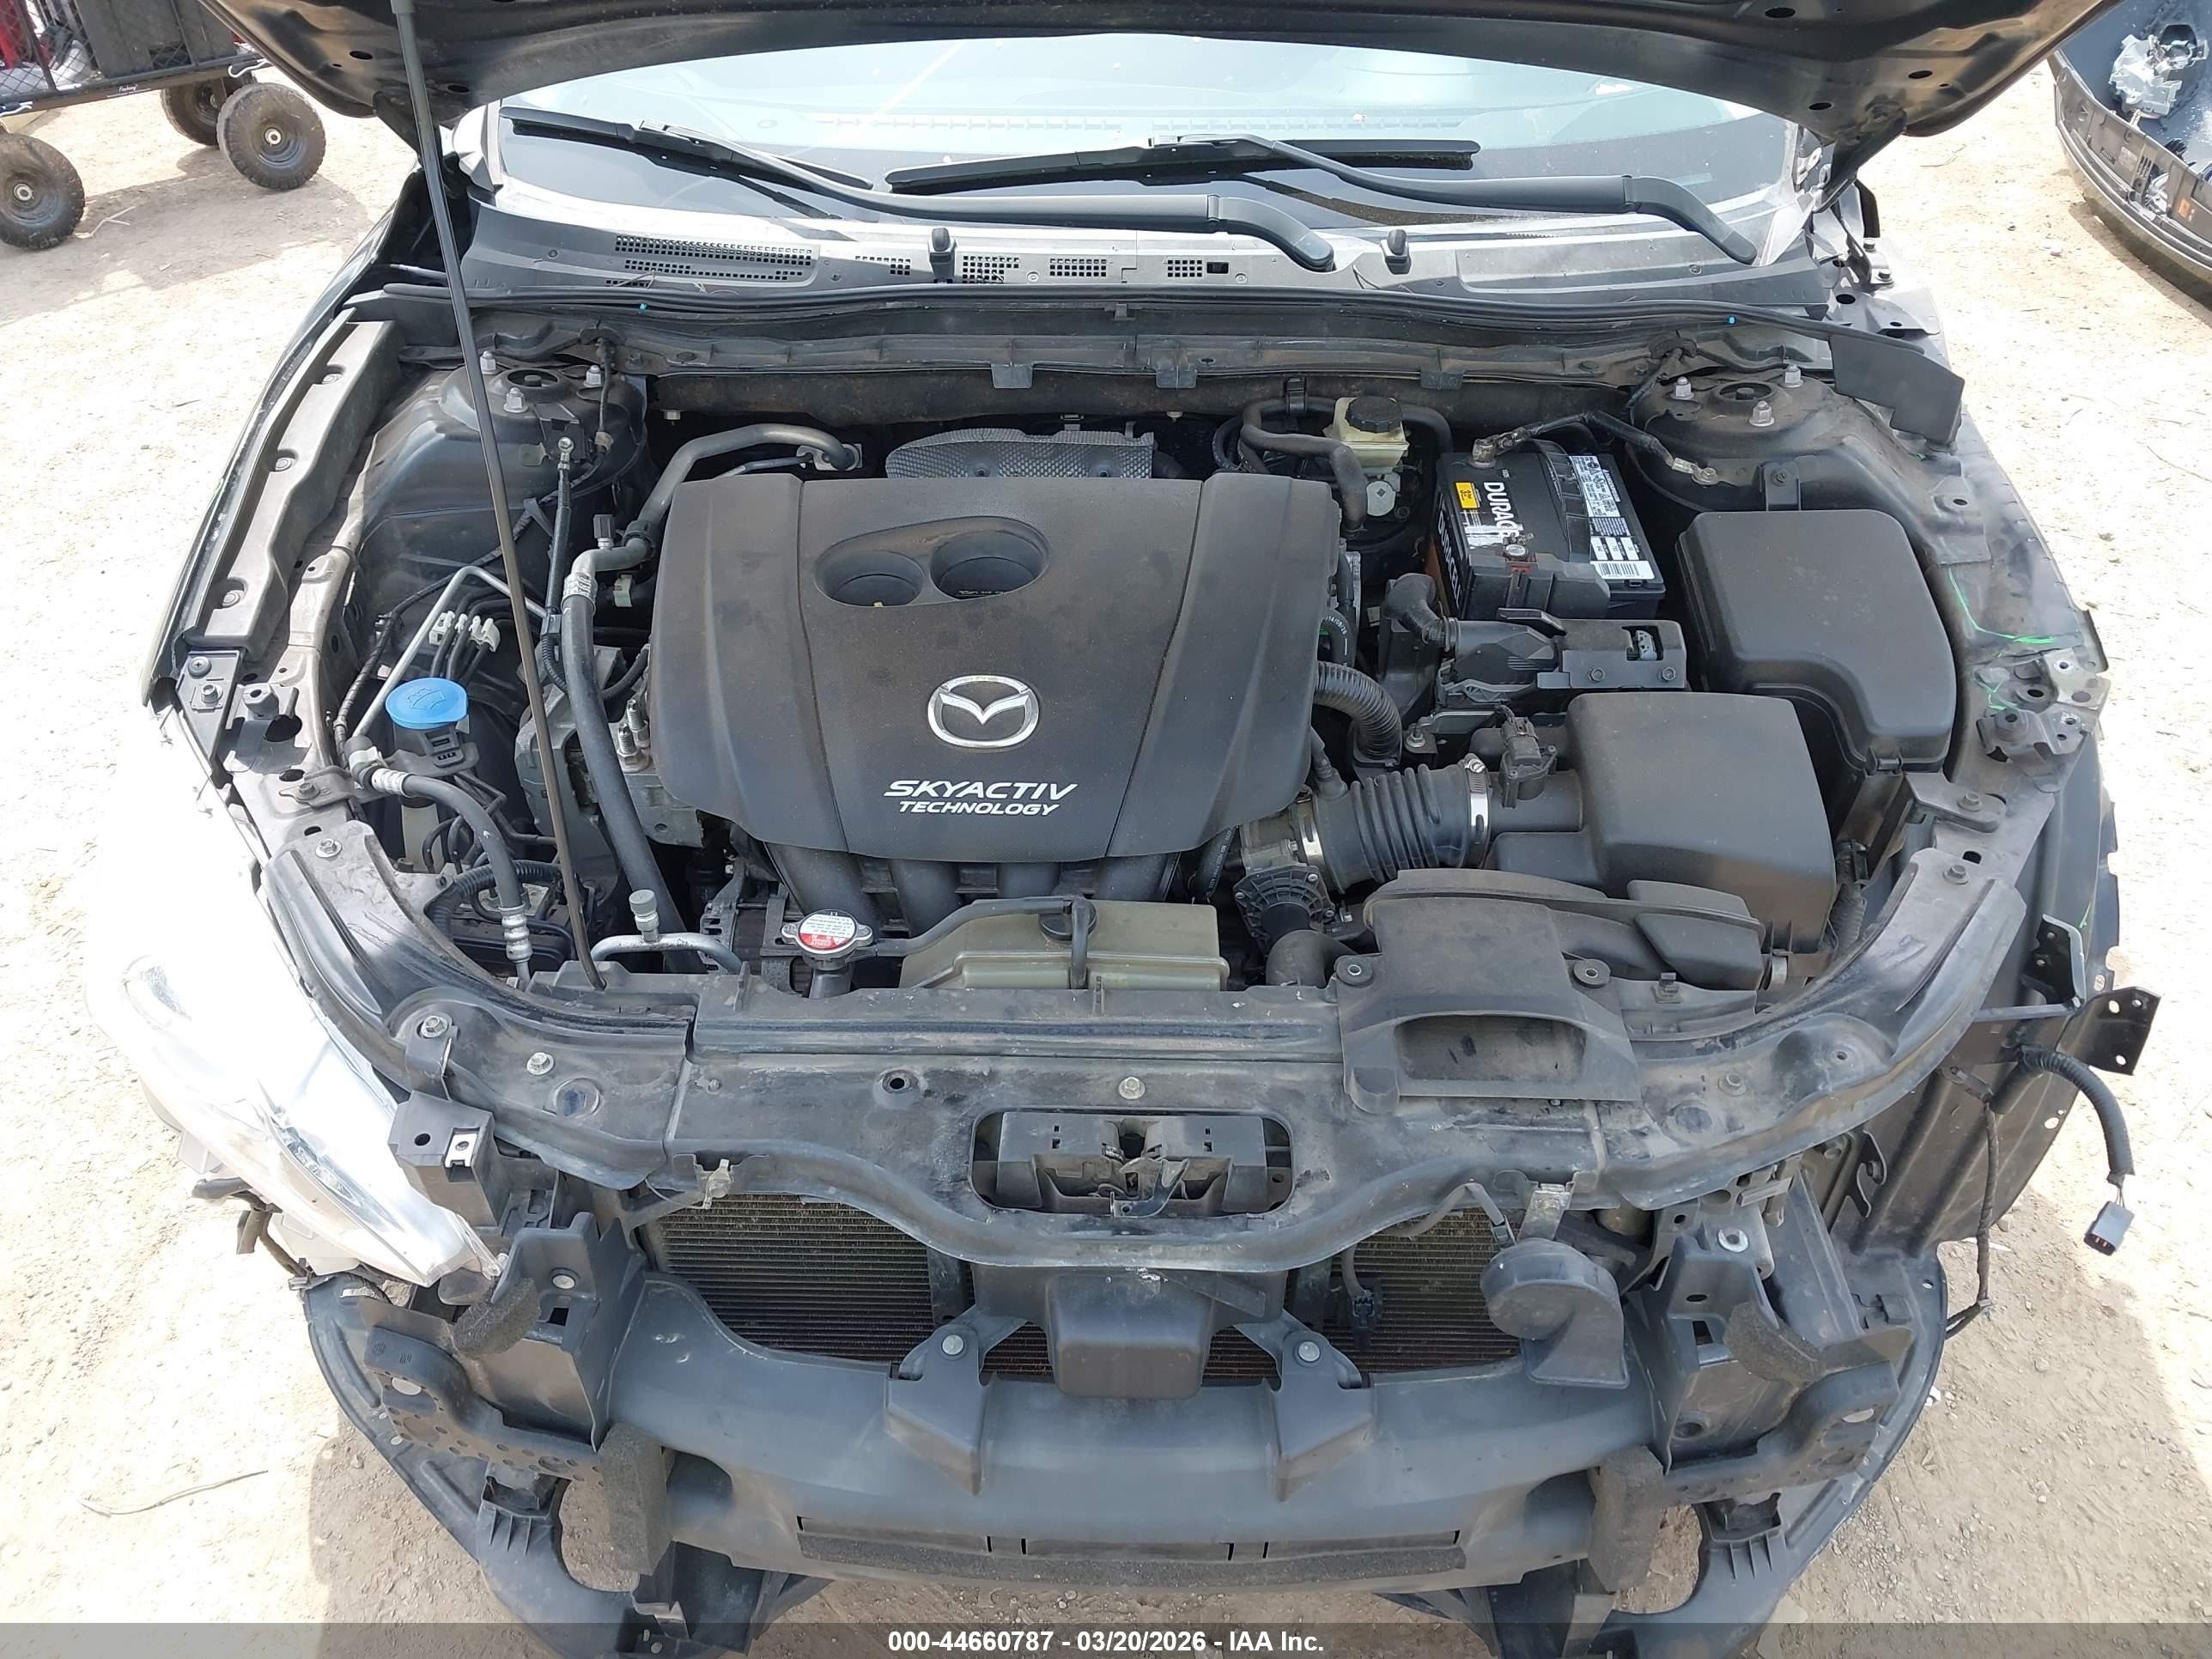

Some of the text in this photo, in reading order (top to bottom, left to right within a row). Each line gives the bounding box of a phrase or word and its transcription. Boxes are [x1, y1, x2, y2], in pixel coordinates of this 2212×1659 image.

[1437, 510, 1461, 610] DURACELL
[883, 780, 1079, 800] SKYACTIV
[899, 800, 1060, 816] TECHNOLOGY
